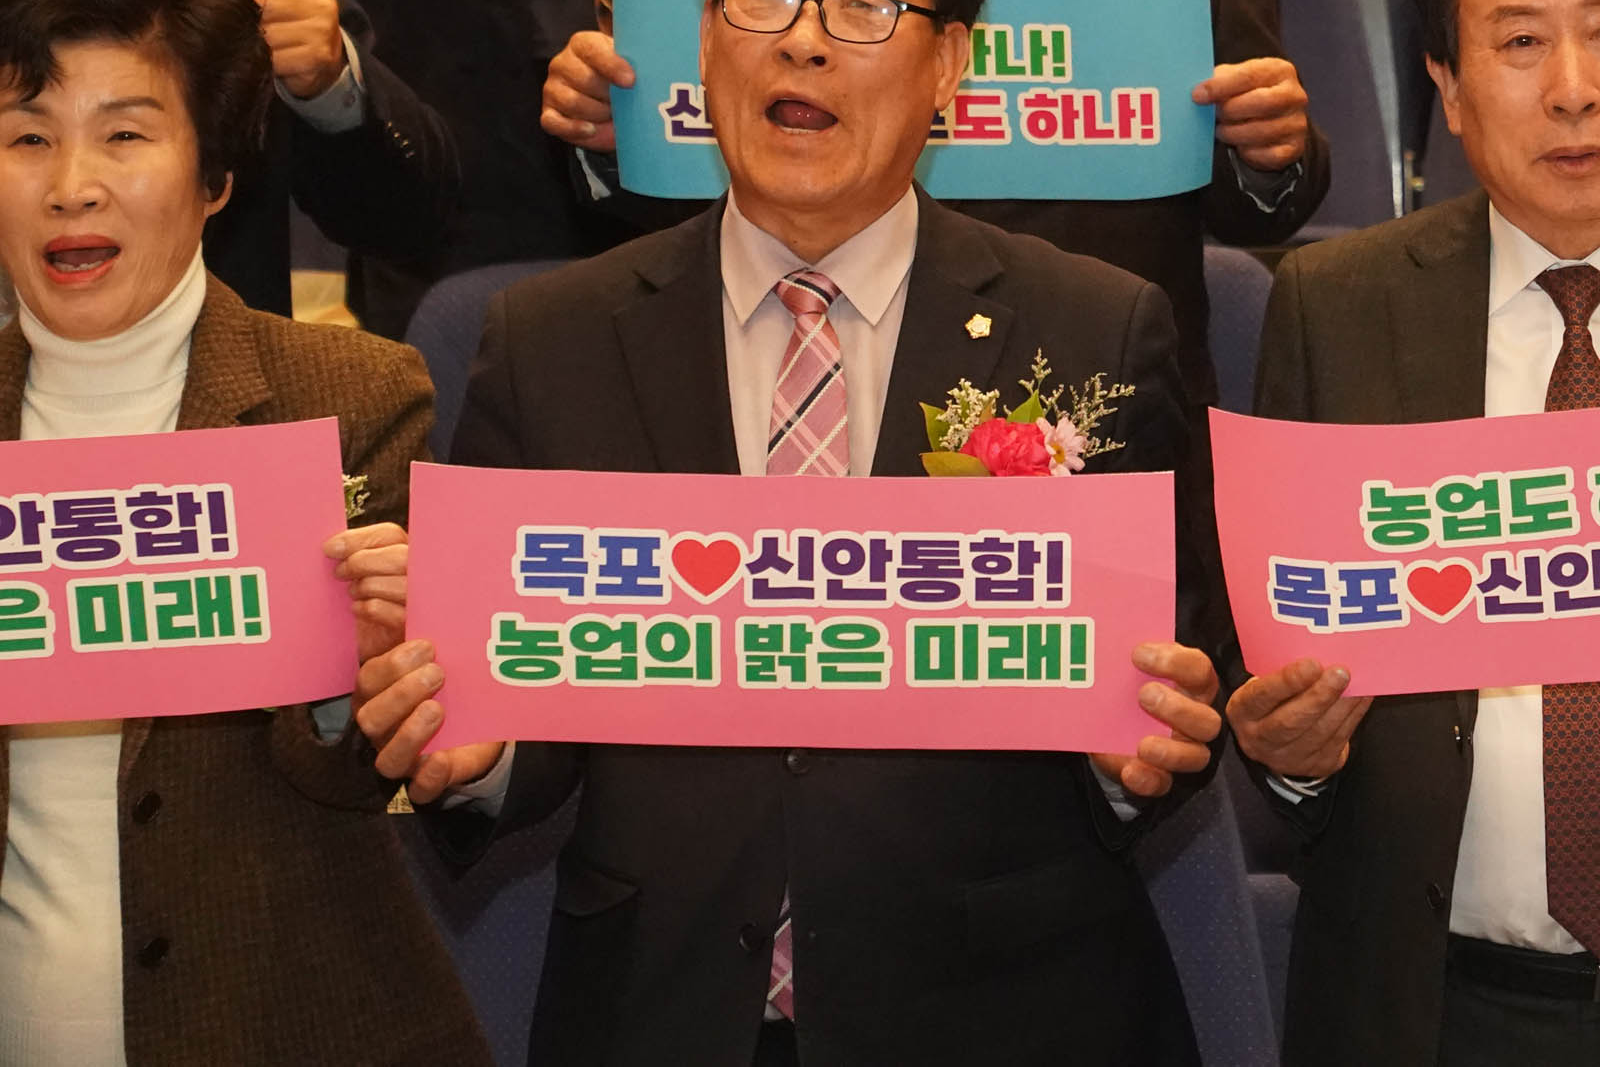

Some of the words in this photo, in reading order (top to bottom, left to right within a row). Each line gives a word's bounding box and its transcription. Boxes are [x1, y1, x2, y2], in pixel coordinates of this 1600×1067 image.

[1022, 92, 1154, 140] 하나!
[1366, 474, 1574, 546] 농업도
[519, 532, 665, 598] 목포
[745, 535, 1065, 604] 신안통합!
[1272, 563, 1400, 627] 목포
[76, 573, 264, 645] 미래!
[494, 619, 715, 682] 농업의
[741, 623, 891, 684] 밝은
[913, 623, 1088, 682] 미래!
